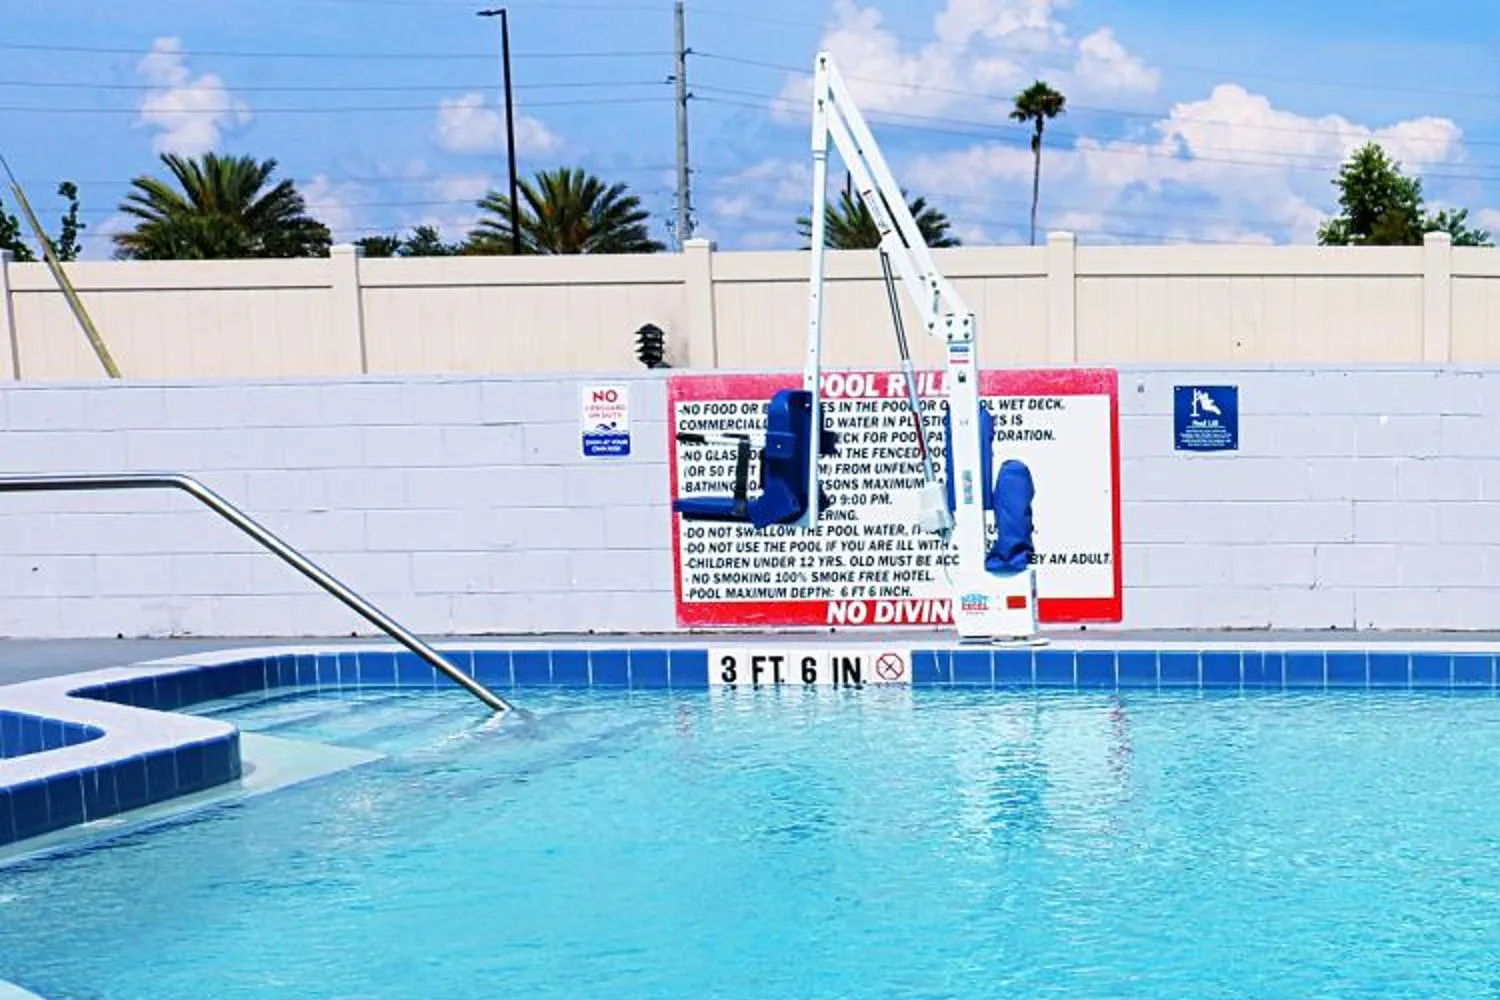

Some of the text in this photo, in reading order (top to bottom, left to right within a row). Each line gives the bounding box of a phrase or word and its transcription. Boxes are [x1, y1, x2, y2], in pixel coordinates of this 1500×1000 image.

[592, 389, 618, 402] NO
[703, 403, 738, 414] FOOD
[742, 403, 759, 414] OR
[838, 401, 852, 412] IN
[855, 401, 878, 412] THE
[999, 399, 1025, 411] WET
[1028, 398, 1065, 411] DECK.
[838, 416, 879, 428] WATER
[883, 416, 895, 427] IN
[1011, 414, 1023, 426] IS
[863, 431, 888, 443] FOR
[846, 448, 868, 459] THE
[872, 447, 920, 458] FENCED
[683, 465, 706, 477] (OR
[709, 465, 725, 476] 50
[835, 463, 871, 474] FROM
[875, 462, 941, 474] UNFENCD
[862, 478, 925, 489] MAXIMUM
[840, 494, 865, 505] 9:00
[870, 493, 893, 504] PM.
[708, 527, 731, 538] NOT
[826, 526, 860, 537] POOL
[863, 524, 909, 536] WATER,
[708, 542, 733, 553] NOT
[736, 542, 759, 553] USE
[763, 541, 786, 552] THE
[789, 541, 822, 552] POOL
[825, 540, 837, 551] IF
[840, 540, 865, 551] YOU
[868, 539, 892, 551] ARE
[895, 539, 914, 550] ILL
[753, 556, 796, 568] UNDER
[799, 556, 815, 567] 12
[818, 556, 846, 566] YRS.
[850, 555, 874, 566] OLD
[877, 555, 912, 566] MUST
[916, 555, 932, 566] BE
[1031, 552, 1112, 565] BY AN ADULT.
[692, 573, 710, 584] NO
[713, 572, 771, 584] SMOKING
[776, 571, 807, 582] 100%
[811, 571, 855, 582] SMOKE
[858, 571, 889, 582] FREE
[893, 570, 935, 581] HOTEL.
[725, 587, 787, 598] MAXIMUM
[790, 586, 834, 598] DEPTH:
[840, 586, 848, 597] 6
[851, 586, 866, 597] FT
[868, 586, 877, 597] 6
[879, 586, 913, 597] INCH.
[827, 601, 867, 624] NO
[721, 656, 736, 683] 3
[801, 657, 817, 684] 6
